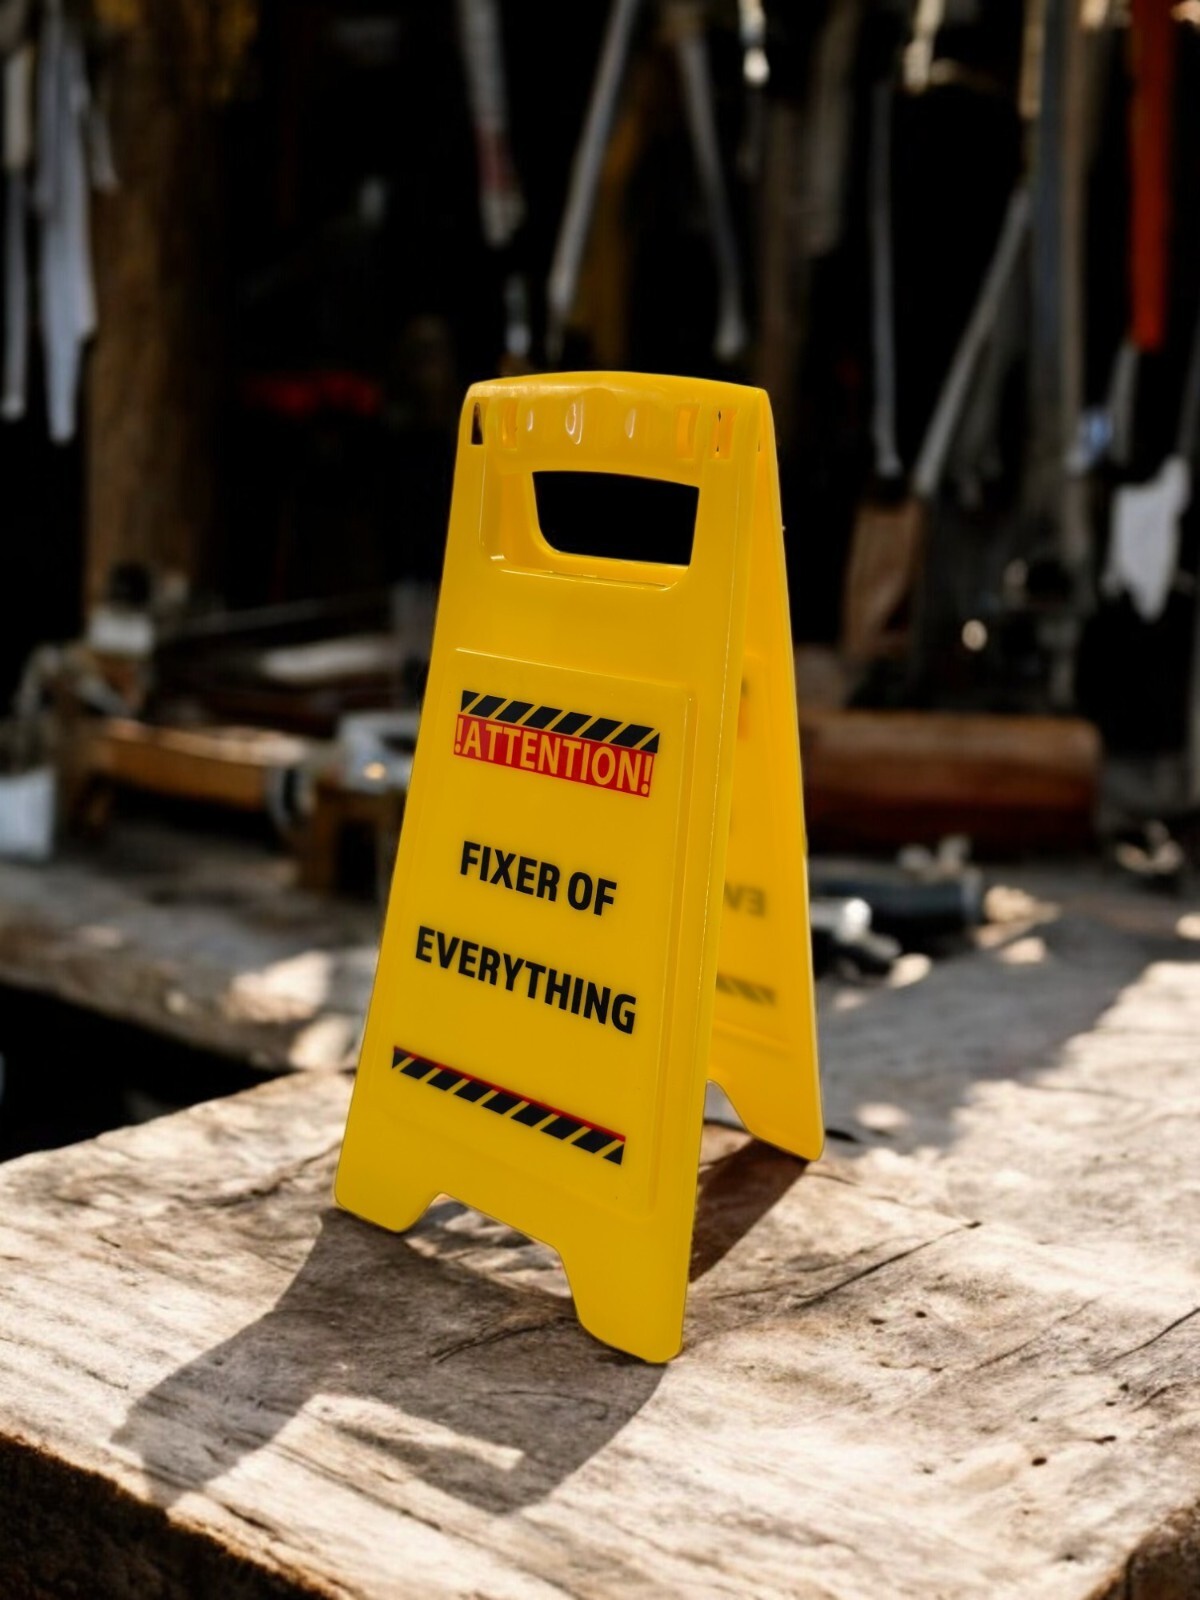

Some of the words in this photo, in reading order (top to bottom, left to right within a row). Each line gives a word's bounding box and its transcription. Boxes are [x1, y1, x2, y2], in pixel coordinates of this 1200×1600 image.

[460, 840, 561, 903] FIXER
[567, 871, 618, 917] OF
[415, 925, 637, 1035] EVERYTHING
